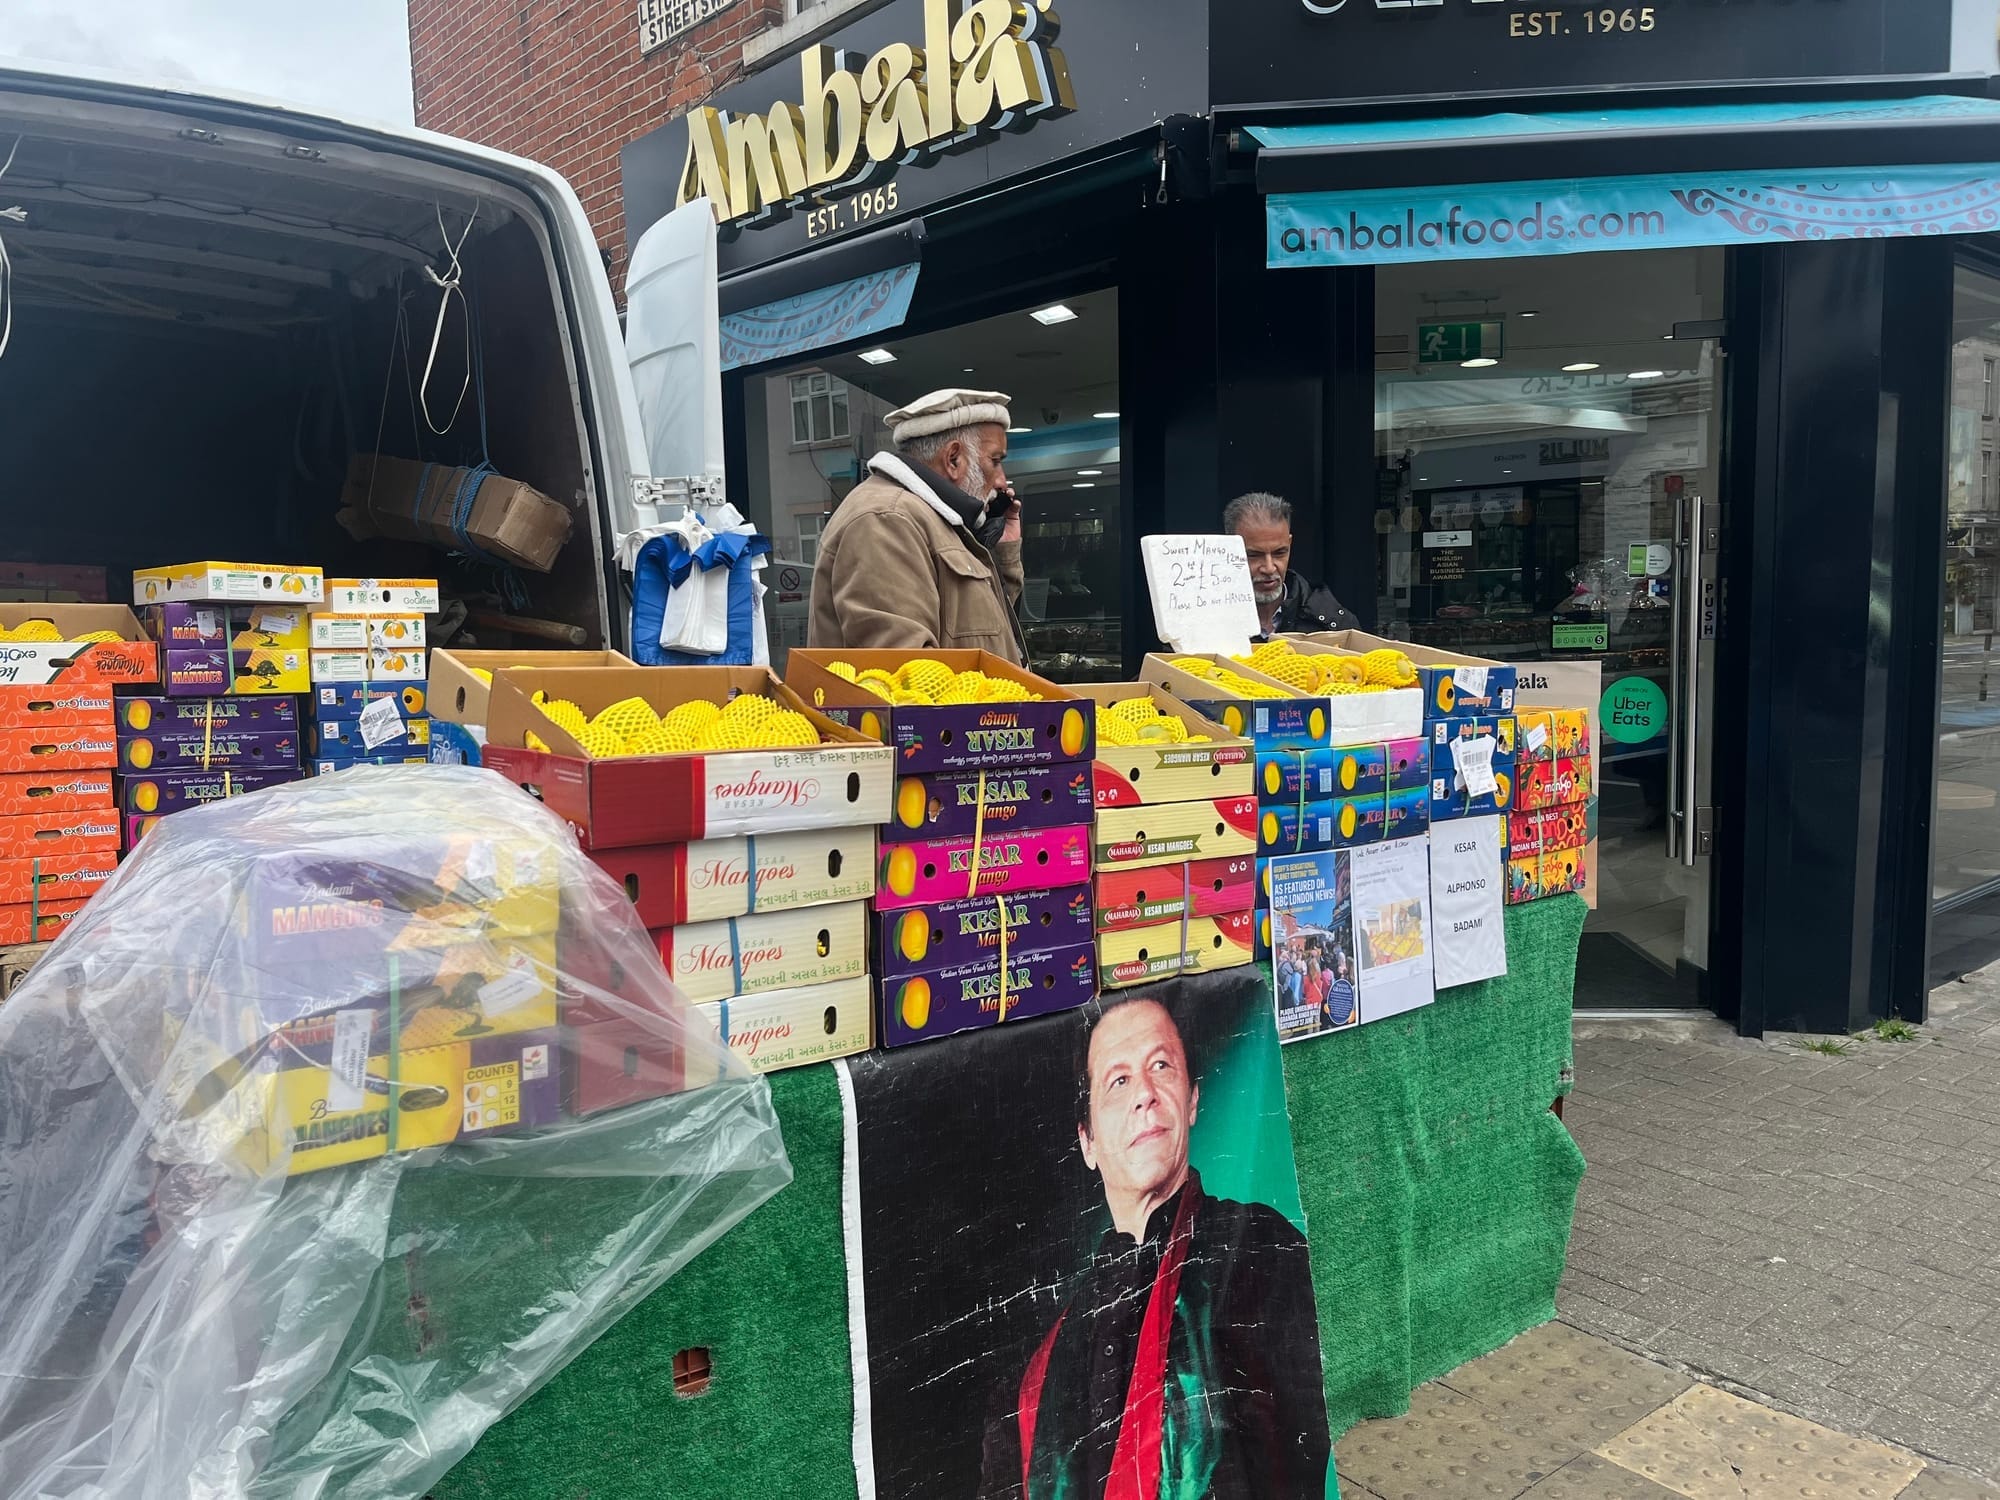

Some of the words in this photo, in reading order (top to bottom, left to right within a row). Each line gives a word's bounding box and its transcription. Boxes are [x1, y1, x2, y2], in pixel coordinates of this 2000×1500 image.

[1509, 11, 1571, 37] EST.
[1584, 8, 1656, 34] 1965
[676, 0, 1040, 222] Ambala
[807, 209, 846, 239] EST.
[852, 182, 898, 223] 1965
[1280, 201, 1665, 253] ambalafoods.com
[235, 564, 262, 572] INDIAN
[1171, 562, 1185, 587] 2
[1225, 592, 1253, 605] HANDLE
[1703, 583, 1714, 635] PUSH
[95, 655, 145, 676] Mangoes
[172, 670, 223, 684] MANGOES
[1614, 696, 1652, 711] Uber
[979, 711, 1020, 728] Mango
[1613, 711, 1650, 726] Eats
[965, 728, 1035, 752] KESAR
[1163, 752, 1192, 764] MANGOES
[1192, 752, 1210, 762] KESAR
[711, 770, 821, 808] Mangoes
[725, 799, 763, 809] KESAR
[1545, 812, 1559, 823] BEST
[1109, 845, 1143, 857] MAHARAJA
[1147, 842, 1165, 855] KESAR
[1166, 840, 1194, 853] MANGOES
[1453, 841, 1477, 854] KESAR
[1511, 841, 1530, 853] INDIAN
[756, 856, 785, 866] ESAR
[301, 882, 354, 902] Badami
[1275, 884, 1283, 896] AS
[1284, 879, 1315, 894] FEATURED
[1316, 877, 1325, 889] ON
[1446, 878, 1486, 895] ALPHONSO
[1274, 895, 1288, 907] BBC
[1289, 891, 1314, 905] LONDON
[1315, 888, 1336, 901] NEWS!
[272, 899, 384, 936] MANGOES
[1107, 909, 1139, 921] MAHARAJA
[1144, 904, 1162, 917] KESAR
[1453, 918, 1483, 933] BADAMI
[744, 938, 774, 949] ESAR
[1114, 966, 1146, 978] MAHARAJA
[1150, 960, 1168, 973] KESAR
[299, 992, 351, 1016] Badami
[745, 1015, 782, 1029] KESAR
[728, 1021, 796, 1056] angoes
[467, 1065, 514, 1080] COUNTS
[506, 1080, 513, 1089] 9
[504, 1095, 516, 1105] 12
[503, 1111, 516, 1121] 15
